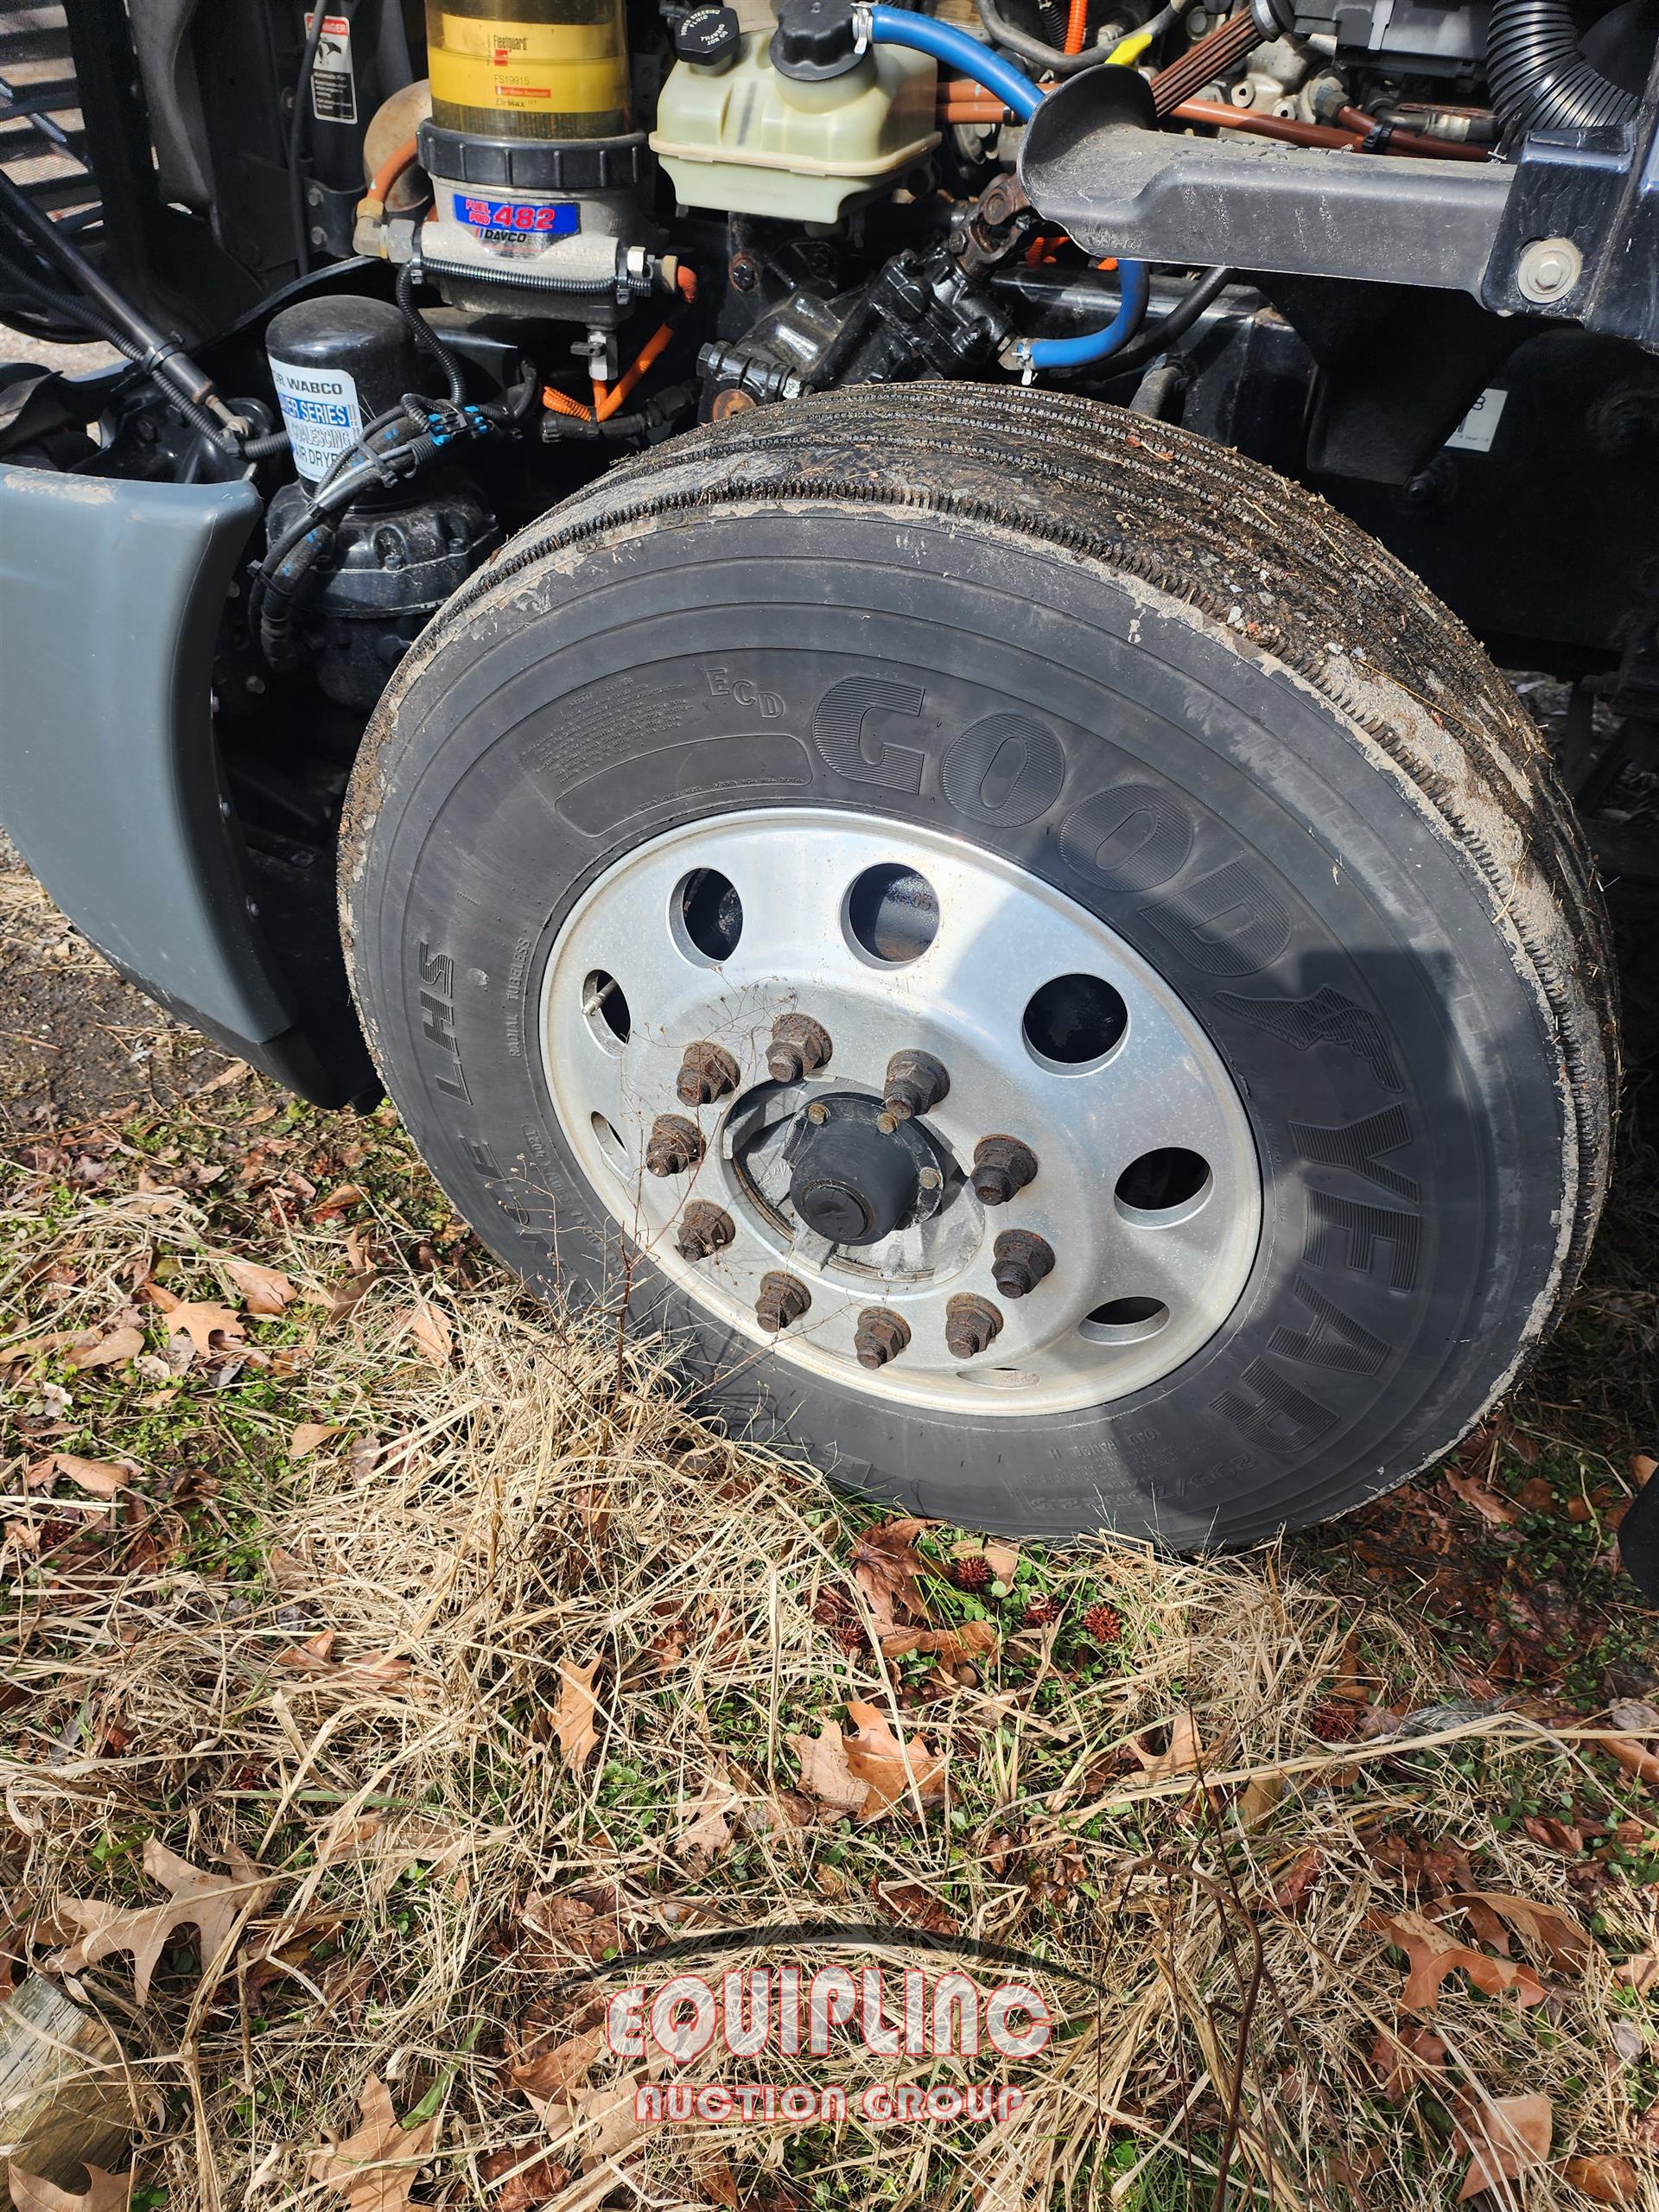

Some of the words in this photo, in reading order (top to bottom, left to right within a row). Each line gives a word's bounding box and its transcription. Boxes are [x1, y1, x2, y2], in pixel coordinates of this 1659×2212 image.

[493, 74, 530, 86] FS19915
[465, 199, 491, 214] FUEL
[493, 205, 556, 230] 482
[468, 211, 491, 226] PRO
[484, 229, 527, 243] DAVCO
[286, 376, 343, 396] WABCO
[300, 401, 347, 426] SERIES
[506, 937, 531, 1001] TUBELESS
[418, 938, 474, 1106] LHS
[505, 1014, 523, 1058] RADIAL
[525, 1129, 547, 1159] 4021
[1050, 1447, 1063, 1460] H
[1077, 1439, 1120, 1459] RANGE
